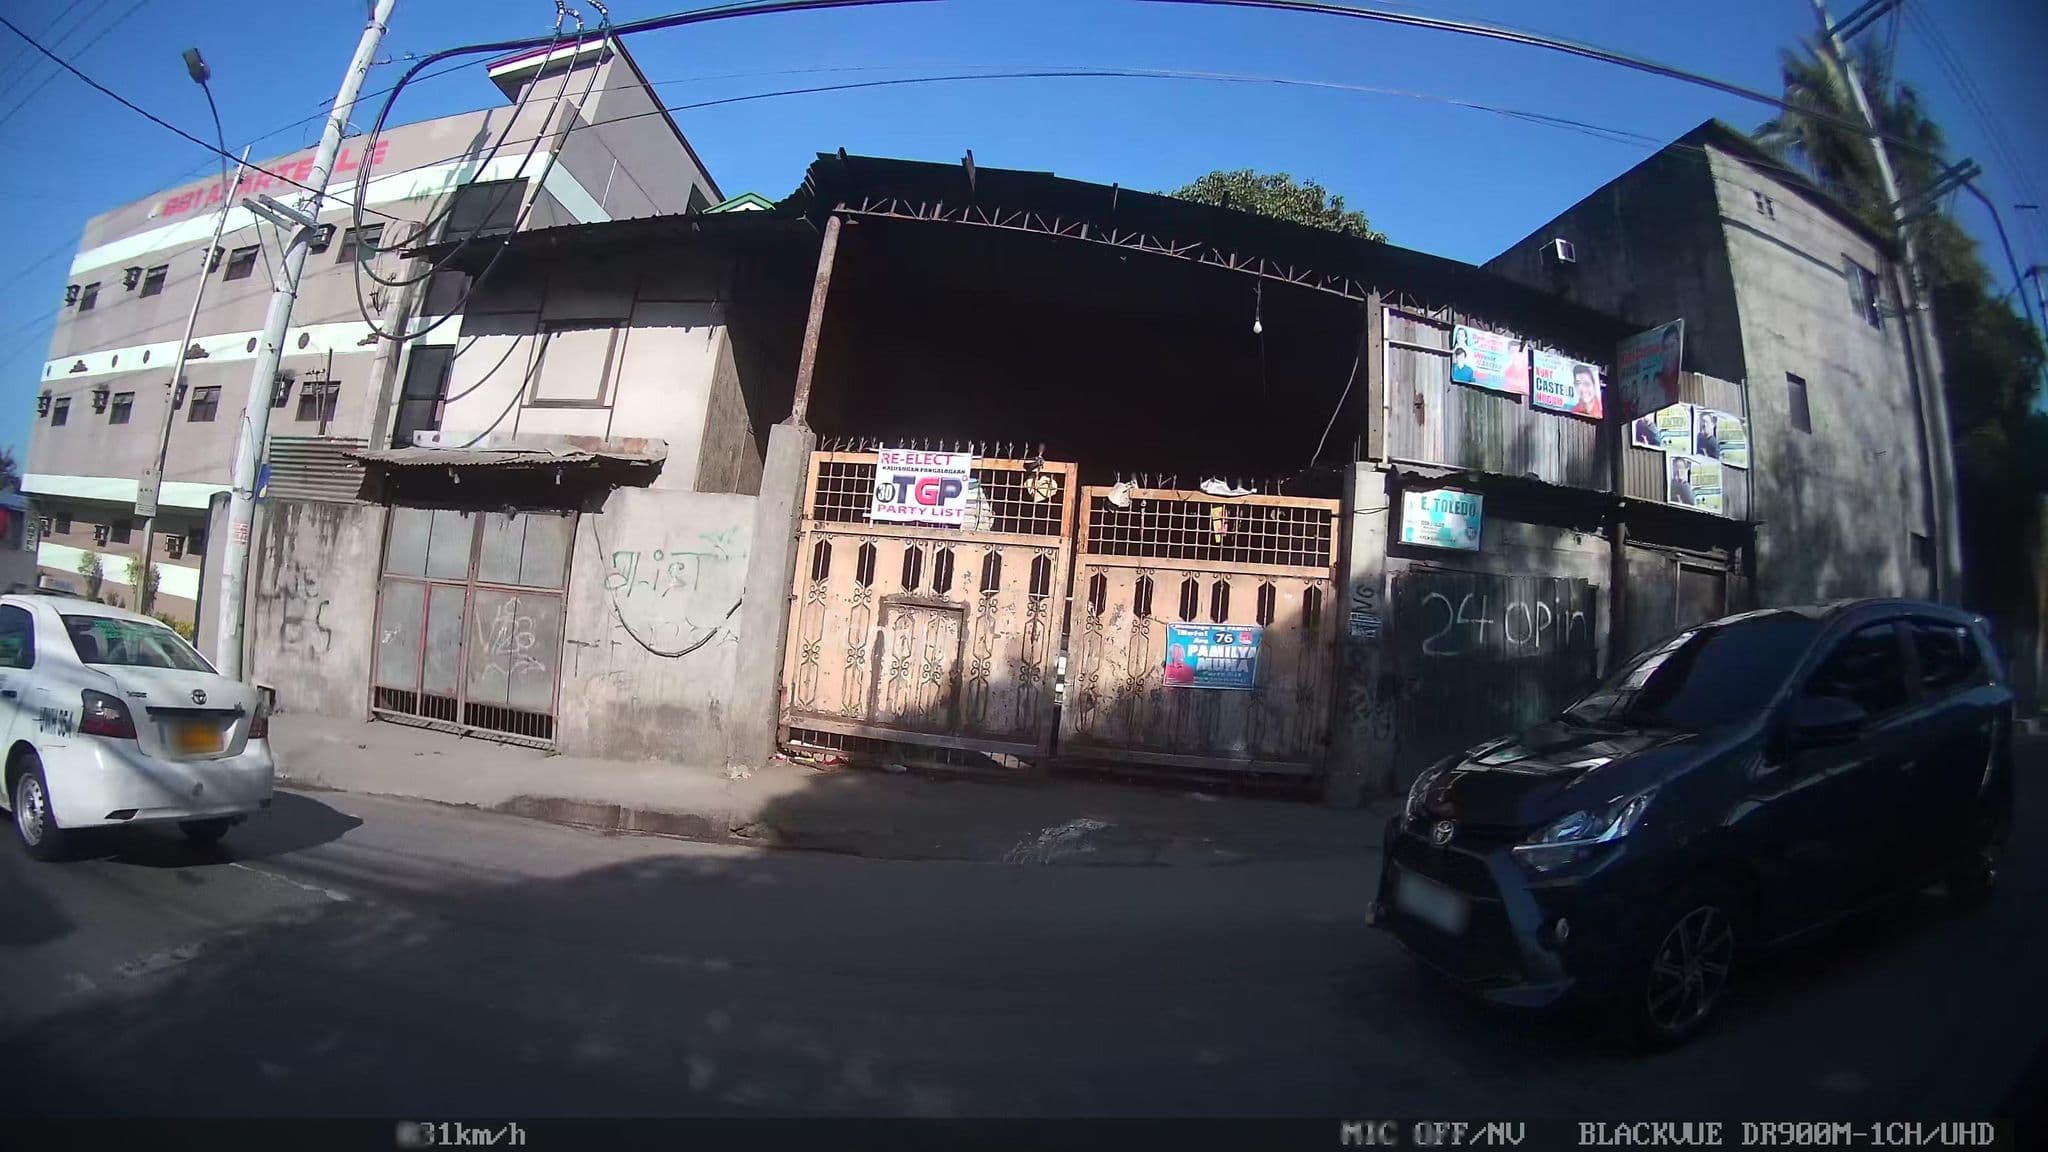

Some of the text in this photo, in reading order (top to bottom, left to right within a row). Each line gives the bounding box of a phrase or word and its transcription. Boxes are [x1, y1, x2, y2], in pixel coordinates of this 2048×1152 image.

[881, 453, 952, 466] RE-ELECT
[893, 474, 963, 507] TGP
[877, 504, 964, 517] PARTY LIST
[1433, 498, 1476, 517] TOLEDO
[1422, 591, 1494, 656] 24
[1215, 633, 1233, 643] 76
[1187, 644, 1257, 659] PAMILYA
